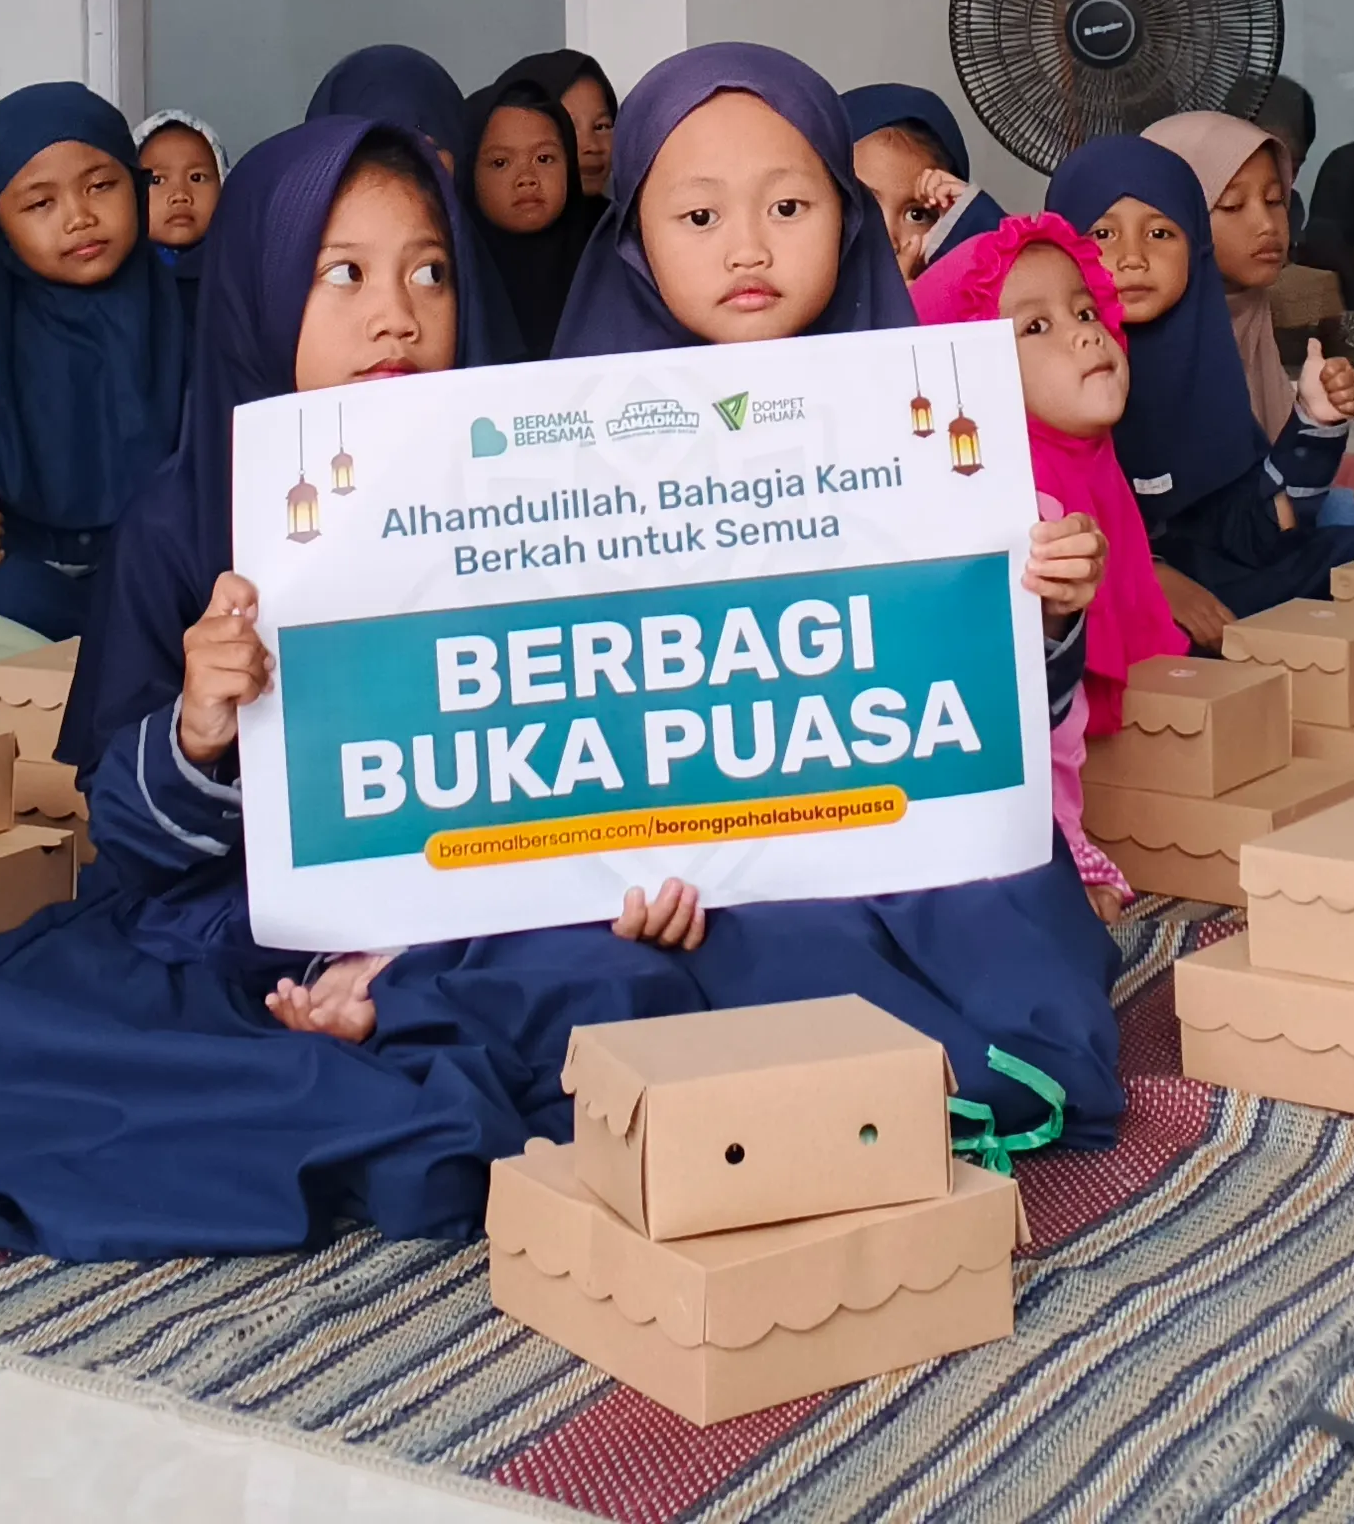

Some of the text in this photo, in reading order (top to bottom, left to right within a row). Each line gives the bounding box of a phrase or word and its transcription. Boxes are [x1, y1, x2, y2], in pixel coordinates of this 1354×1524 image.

[624, 400, 681, 418] SUPER
[752, 397, 805, 412] DOMPET
[753, 409, 806, 424] DHUAFA
[513, 409, 594, 431] BERAMAL
[606, 412, 699, 436] RAMADHAN
[514, 426, 595, 447] BERSAMA
[381, 456, 903, 539] Alhamdulillah, Bahagia Kami
[454, 514, 840, 576] Berkah untuk Semua
[435, 594, 876, 713] BERBAGI
[340, 679, 981, 819] BUKA PUASA
[439, 797, 895, 859] beramalbersama.com/borongpahalabukapuasa
